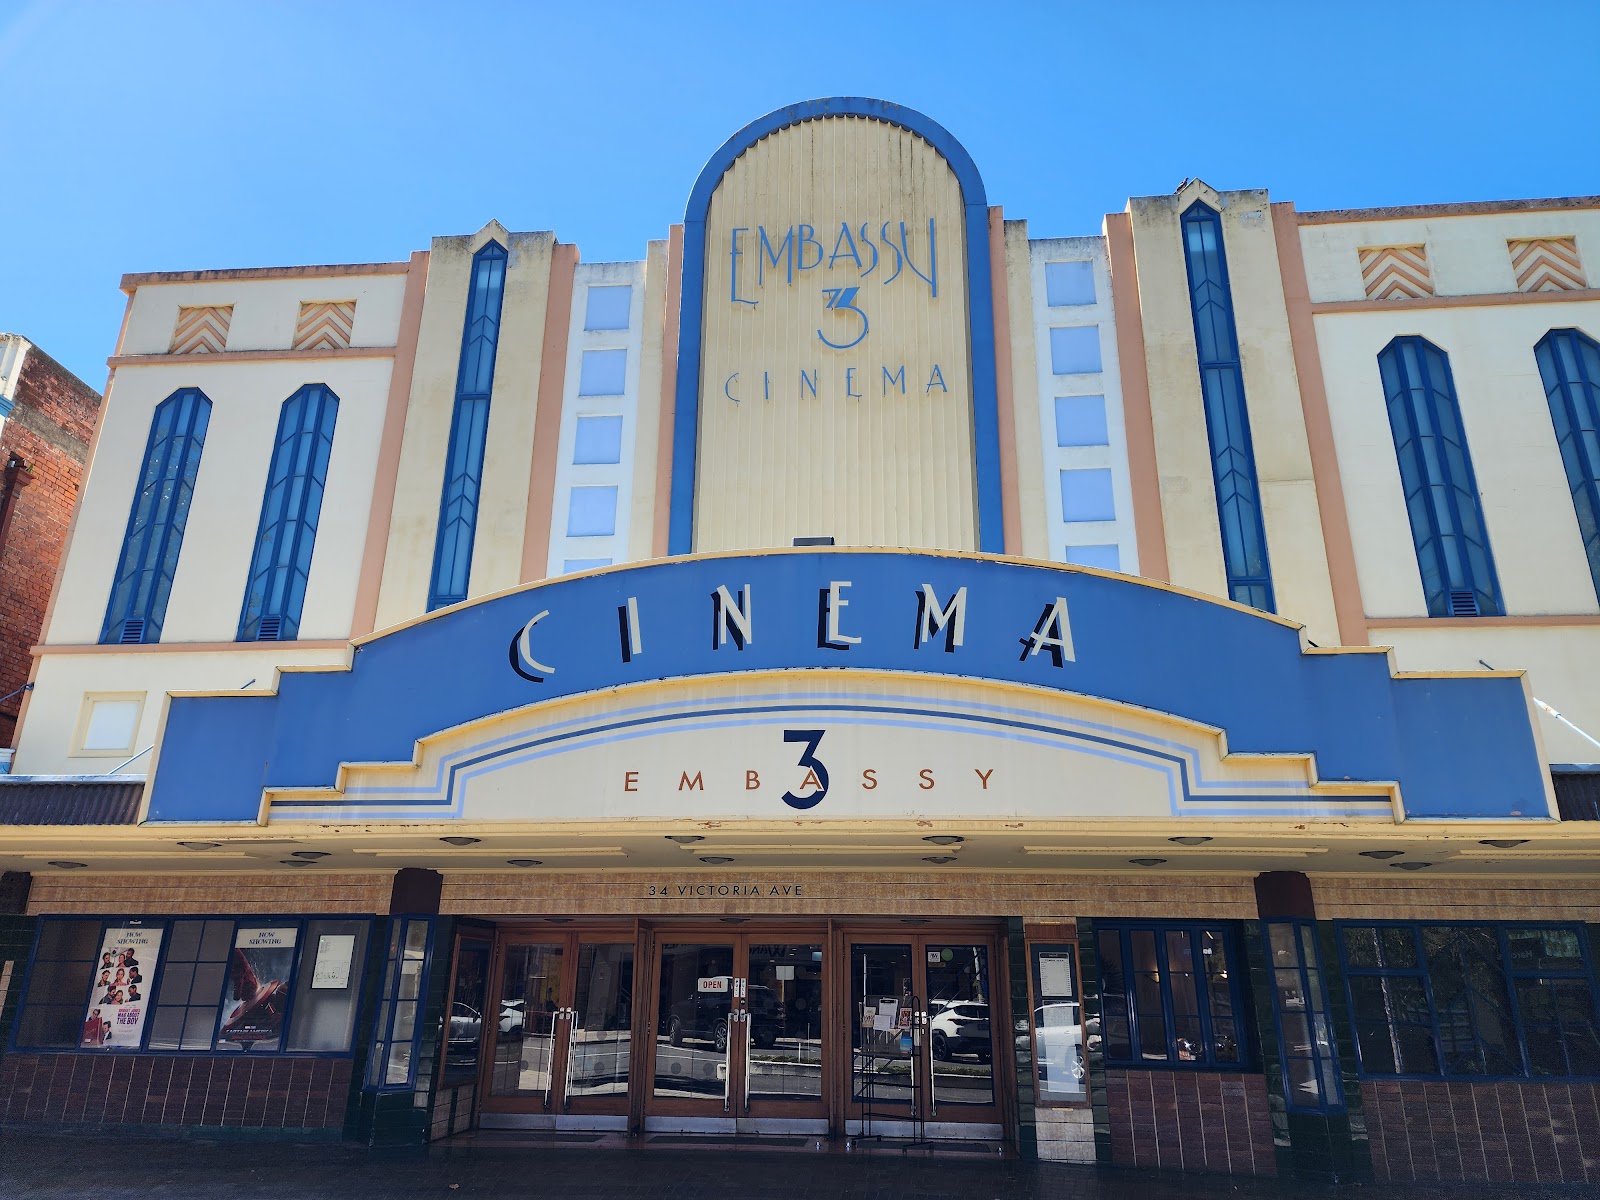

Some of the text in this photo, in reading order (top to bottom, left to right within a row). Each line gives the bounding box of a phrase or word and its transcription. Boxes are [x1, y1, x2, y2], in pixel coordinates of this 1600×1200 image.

[730, 217, 937, 305] EMBASSY
[817, 286, 869, 349] 3
[725, 364, 948, 402] CINEMA
[508, 580, 1077, 683] CINEMA
[624, 768, 994, 792] EMBASSY
[781, 729, 829, 809] 3
[648, 885, 802, 896] 34 VICTORIA AVE
[703, 980, 722, 989] OPEN
[116, 1017, 139, 1025] THE BOY
